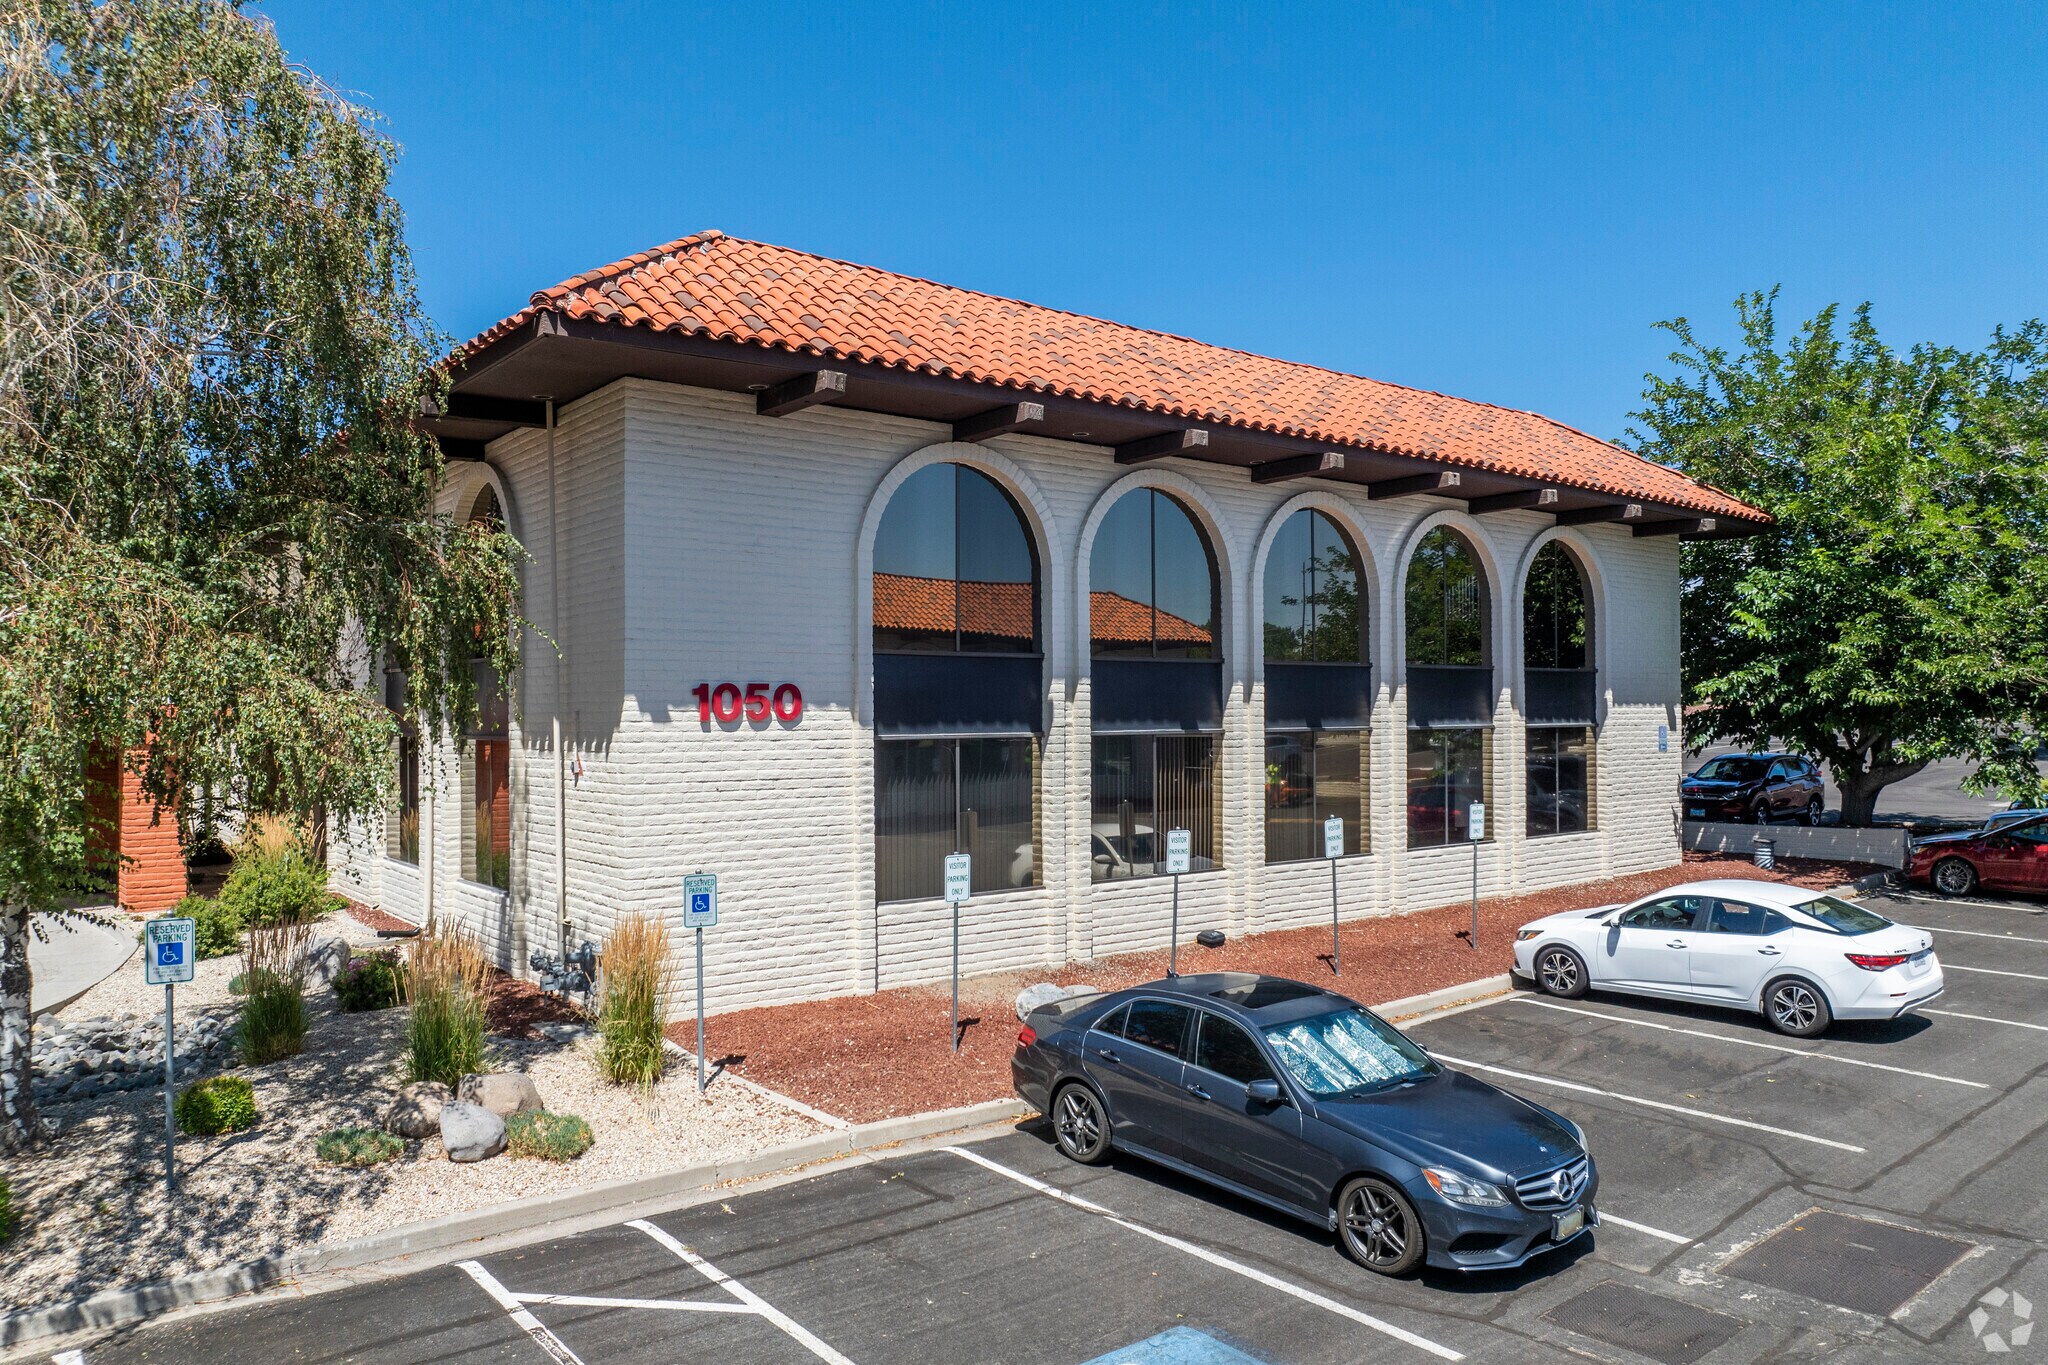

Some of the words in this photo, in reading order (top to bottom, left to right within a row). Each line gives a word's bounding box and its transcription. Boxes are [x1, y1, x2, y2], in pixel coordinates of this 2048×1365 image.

[692, 683, 802, 721] 1050
[686, 879, 714, 887] RESERVED
[688, 886, 712, 894] PARKING
[149, 924, 191, 934] RESERVED
[153, 933, 187, 943] PARKING
